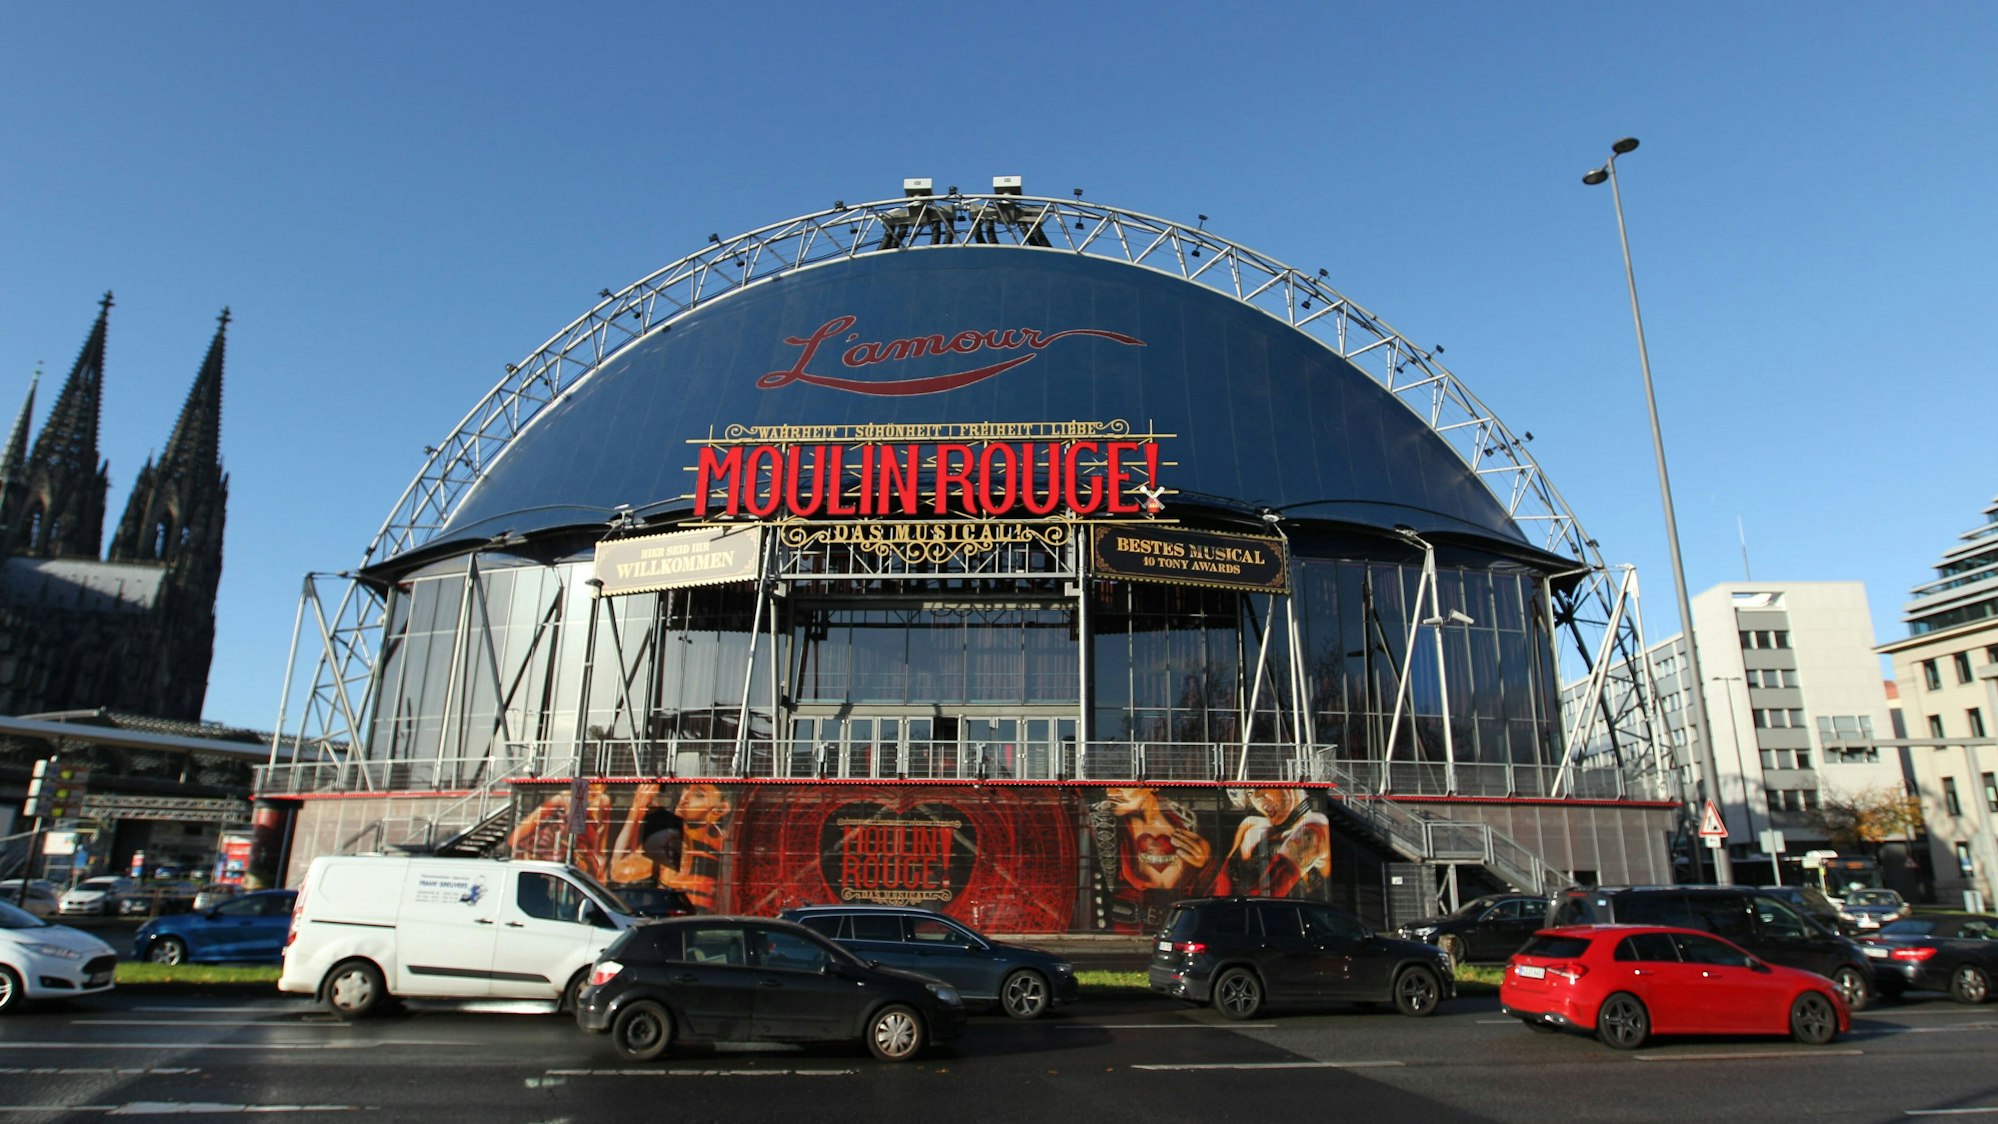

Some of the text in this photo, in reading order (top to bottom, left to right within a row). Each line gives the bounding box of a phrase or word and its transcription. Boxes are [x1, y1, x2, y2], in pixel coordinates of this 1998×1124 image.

[756, 315, 1147, 397] L'amour
[758, 422, 1096, 439] WAHRHEIT SCHÖNHEIT FREIHEIT LIEBE
[693, 441, 1161, 517] MOULIN ROUGE!
[835, 523, 1023, 541] DAS MUSICAL!
[641, 541, 710, 560] HIER SEID IHR
[1116, 536, 1265, 565] BESTES MUSICAL
[616, 550, 735, 579] WILLKOMMEN
[1143, 556, 1241, 575] 10 TONY AWARDS
[842, 825, 938, 856] MOULIN
[860, 891, 880, 900] DAS
